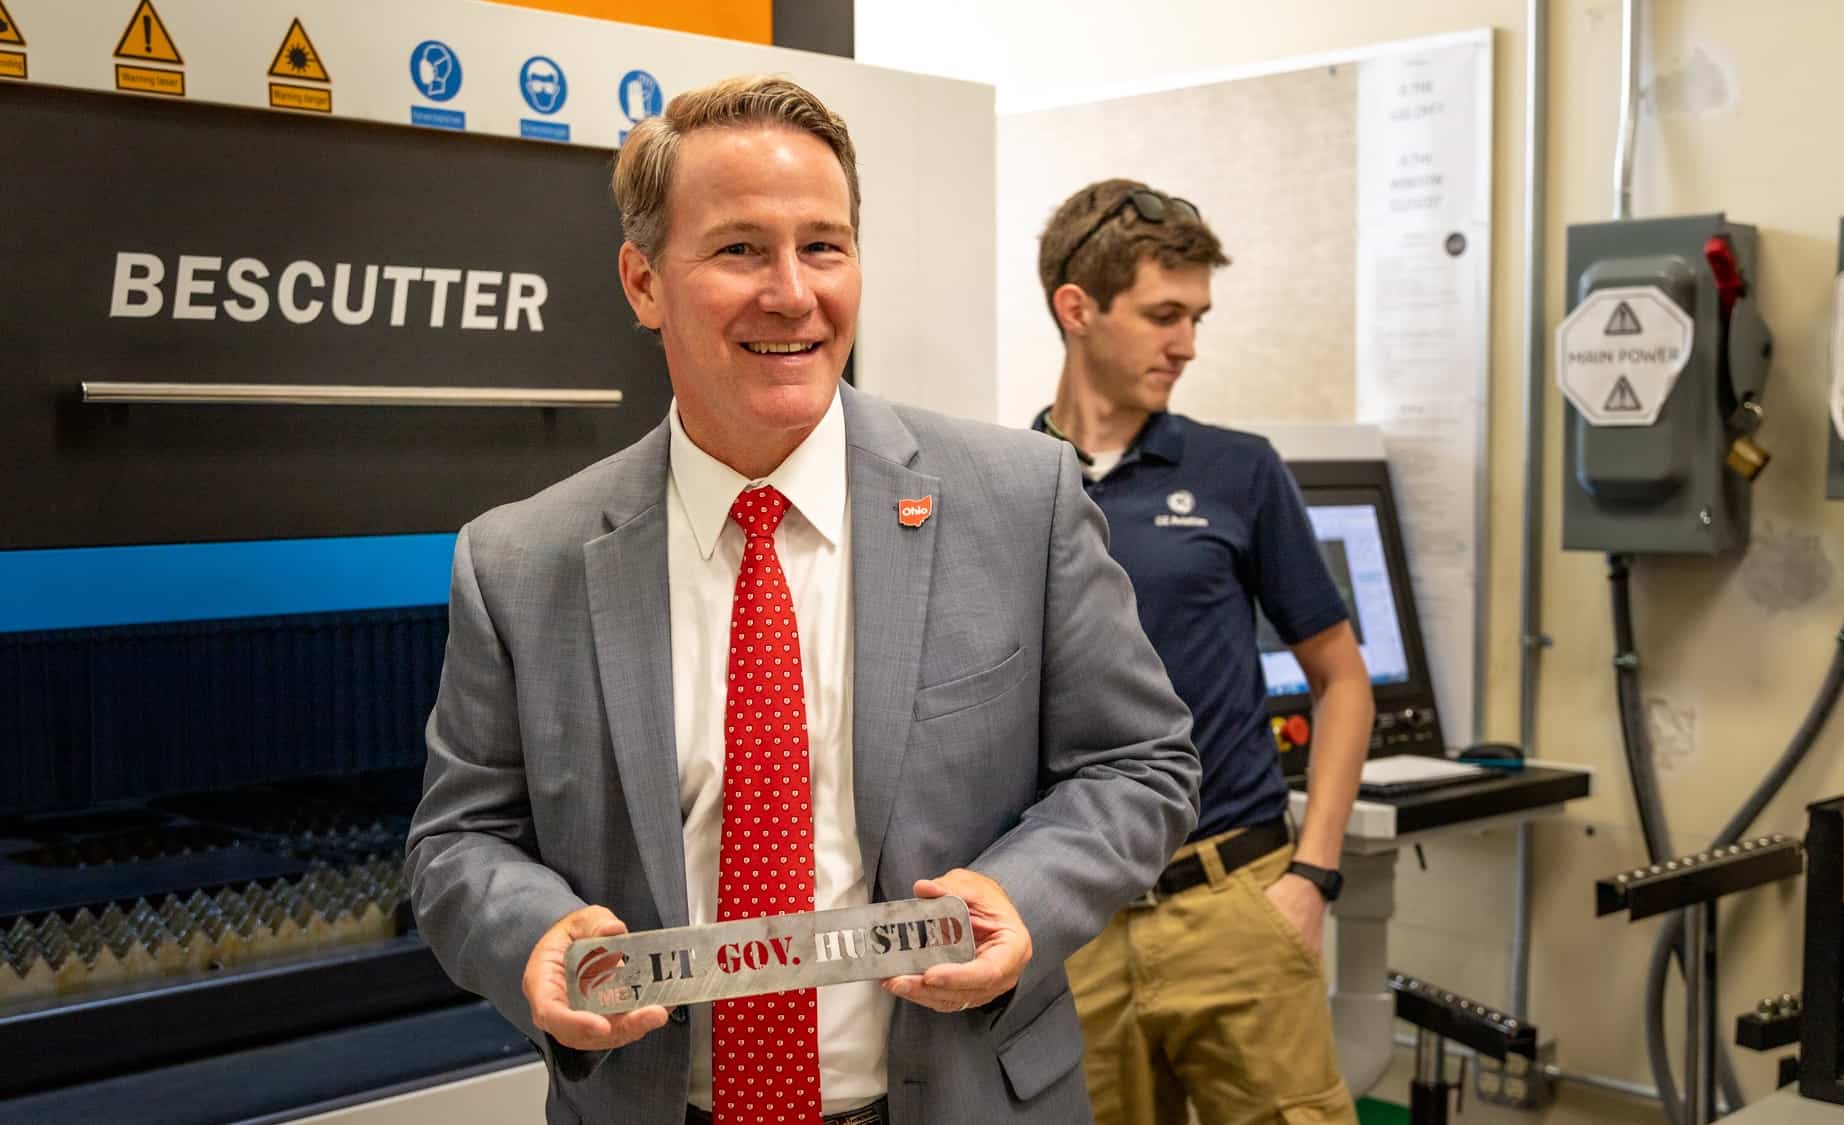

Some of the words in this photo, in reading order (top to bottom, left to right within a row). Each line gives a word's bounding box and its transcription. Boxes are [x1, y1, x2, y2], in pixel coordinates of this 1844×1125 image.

[109, 251, 549, 332] BESCUTTER
[1568, 349, 1613, 365] MAIN
[1618, 346, 1678, 364] POWER
[902, 505, 928, 517] Ohio
[717, 936, 800, 974] GOV.
[814, 916, 963, 963] HUSTED
